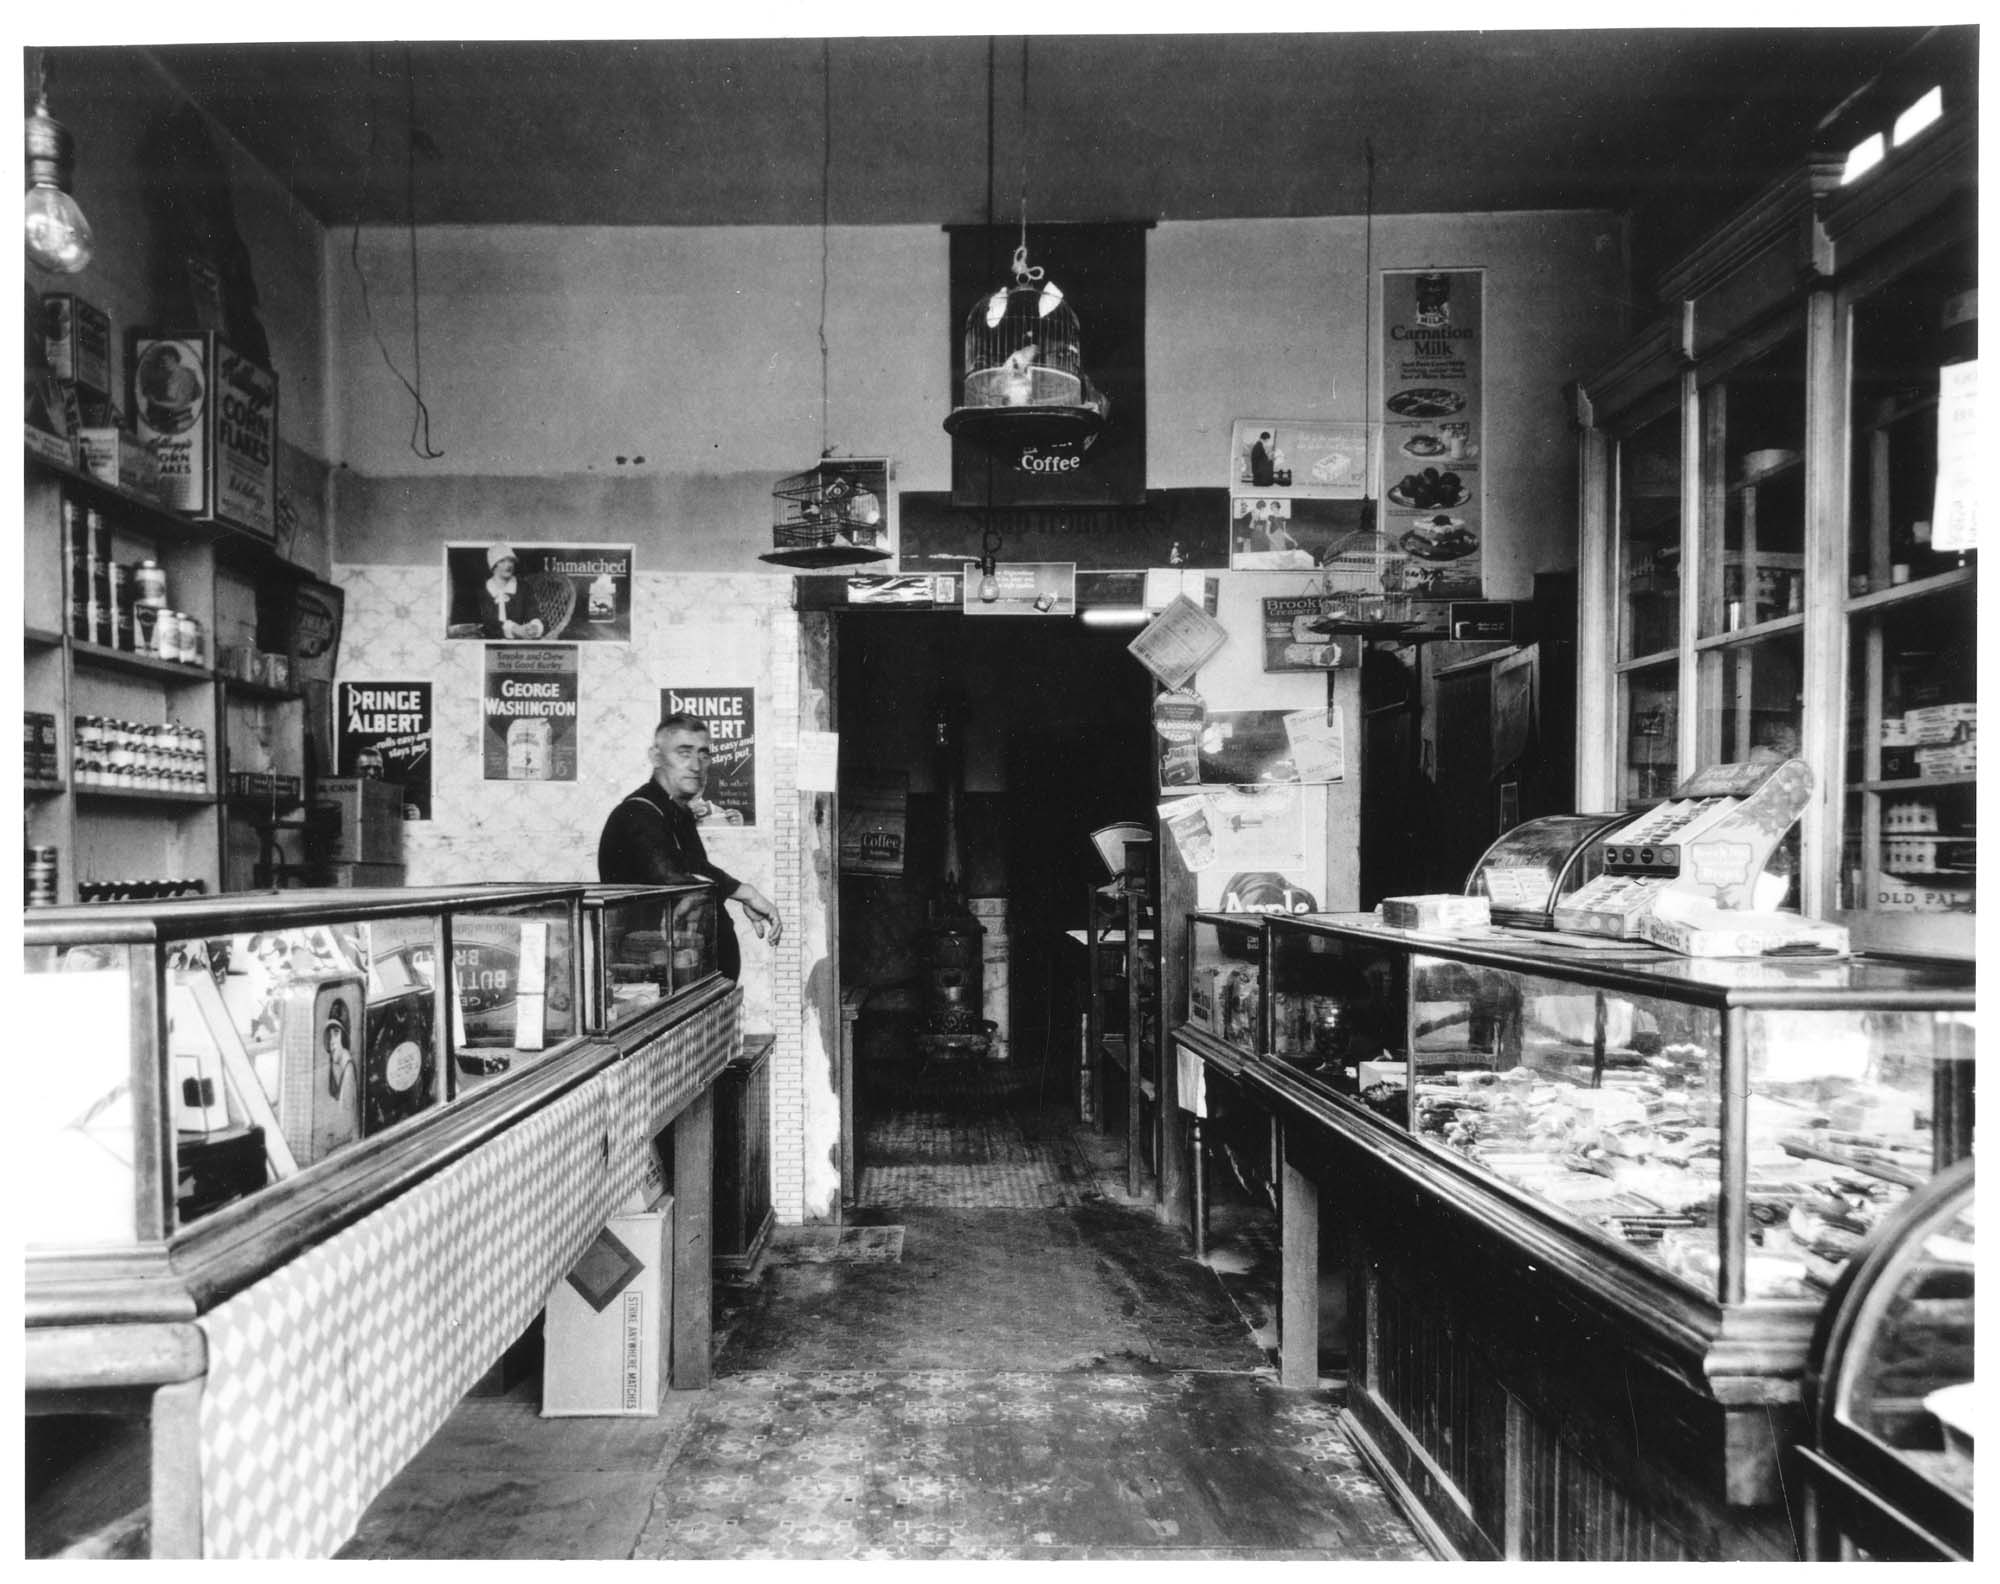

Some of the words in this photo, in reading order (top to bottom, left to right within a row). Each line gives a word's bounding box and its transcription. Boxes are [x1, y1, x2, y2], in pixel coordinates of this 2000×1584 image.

[1391, 325, 1473, 340] Carnation
[1415, 341, 1454, 355] Milk
[160, 453, 190, 462] ORN
[1022, 455, 1080, 472] Coffee
[160, 464, 192, 474] AKES
[543, 556, 627, 573] Unmatched
[502, 680, 560, 697] GEORGE
[485, 697, 576, 716] WASHINGTON
[347, 709, 423, 733] ALBERT
[720, 738, 738, 752] easy
[711, 754, 733, 766] stays
[862, 834, 899, 848] Coffee
[1878, 892, 1915, 904] OLD
[627, 1296, 639, 1323] STRIKE
[626, 1327, 638, 1370] ANYWHERE
[626, 1371, 638, 1410] MATCHES
